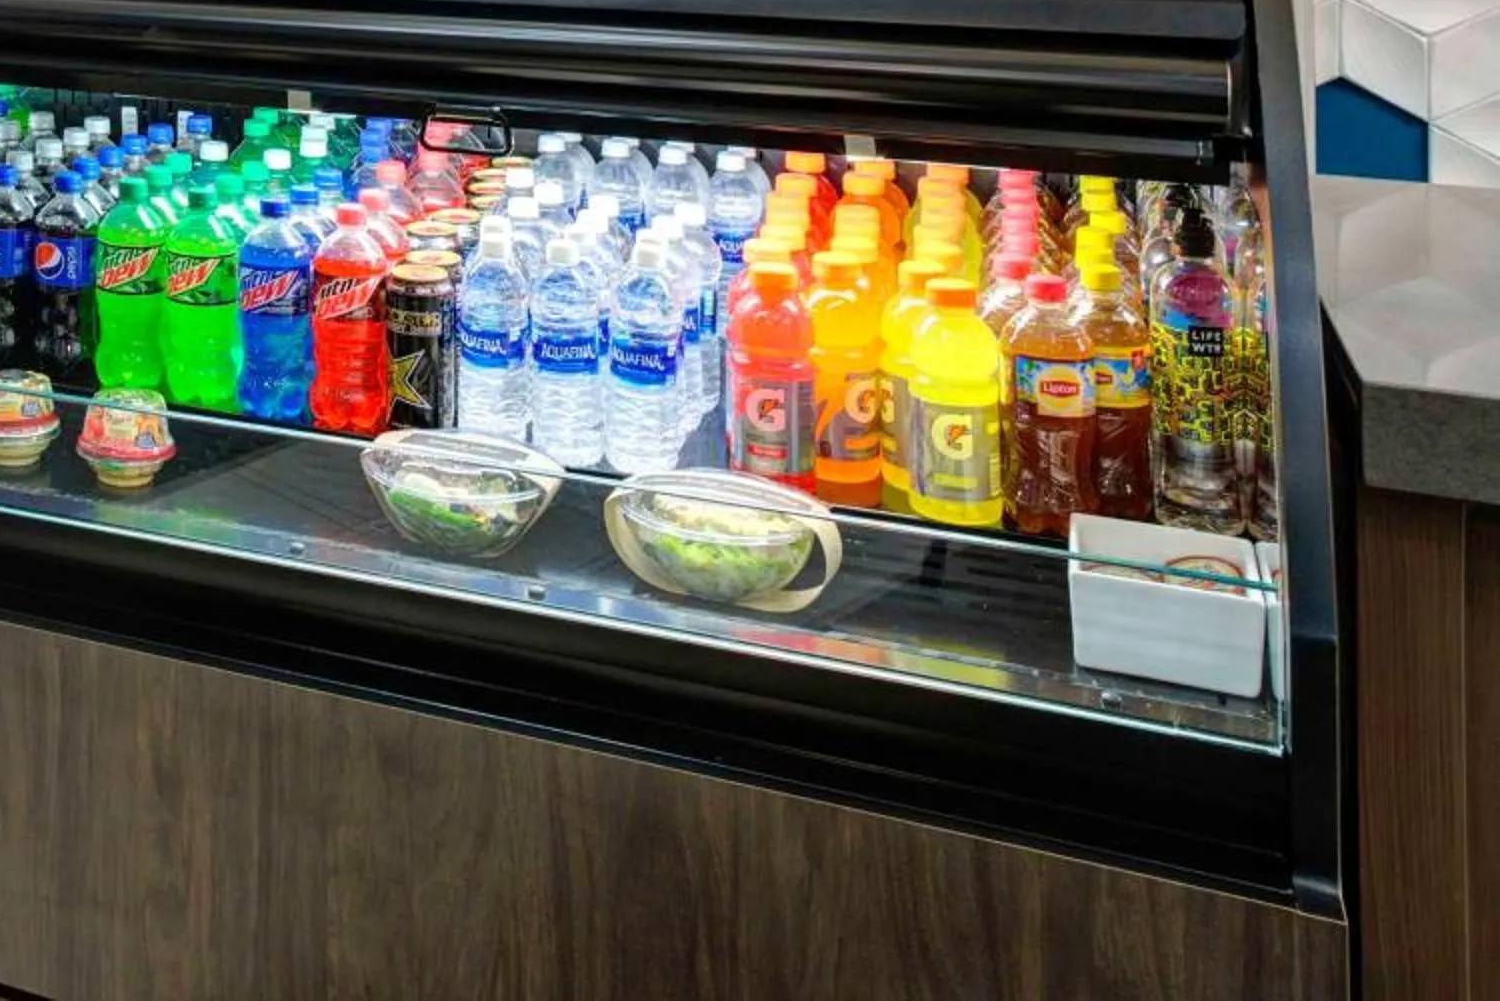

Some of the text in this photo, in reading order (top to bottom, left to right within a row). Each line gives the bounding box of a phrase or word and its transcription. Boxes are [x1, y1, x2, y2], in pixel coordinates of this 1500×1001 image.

[1191, 329, 1221, 342] LIFE
[539, 342, 597, 361] AQUAFINA
[611, 346, 665, 372] AQUAFINA
[1043, 381, 1078, 396] Lipton
[745, 388, 787, 432] G
[931, 413, 973, 460] G
